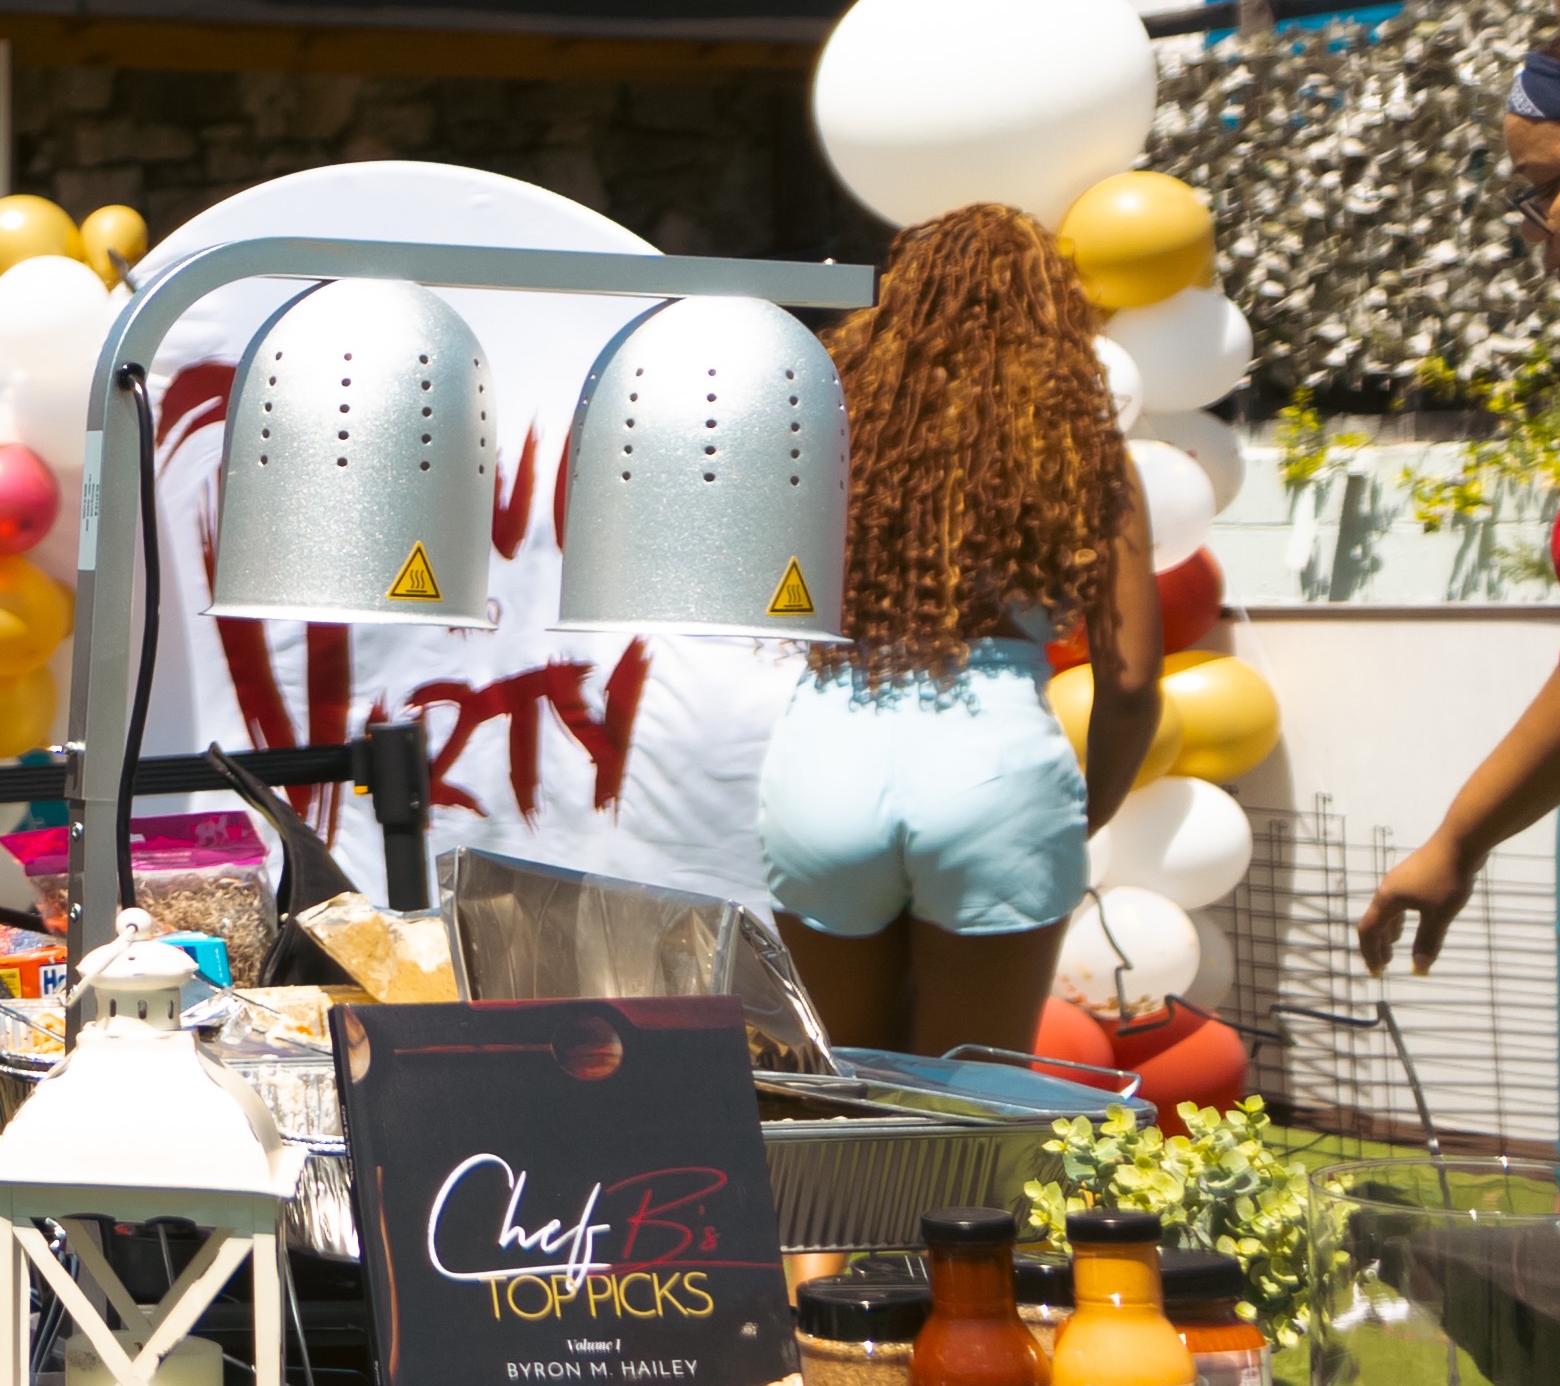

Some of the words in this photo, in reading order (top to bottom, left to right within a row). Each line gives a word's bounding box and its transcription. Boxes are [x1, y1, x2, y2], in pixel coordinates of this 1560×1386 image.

[427, 1153, 612, 1295] Chef
[605, 1166, 728, 1276] B's
[478, 1274, 577, 1321] TOP
[586, 1271, 714, 1319] PICKS
[566, 1338, 614, 1354] Volume
[507, 1361, 582, 1379] BYRON
[590, 1360, 614, 1379] M.
[621, 1359, 698, 1379] HAILEY
